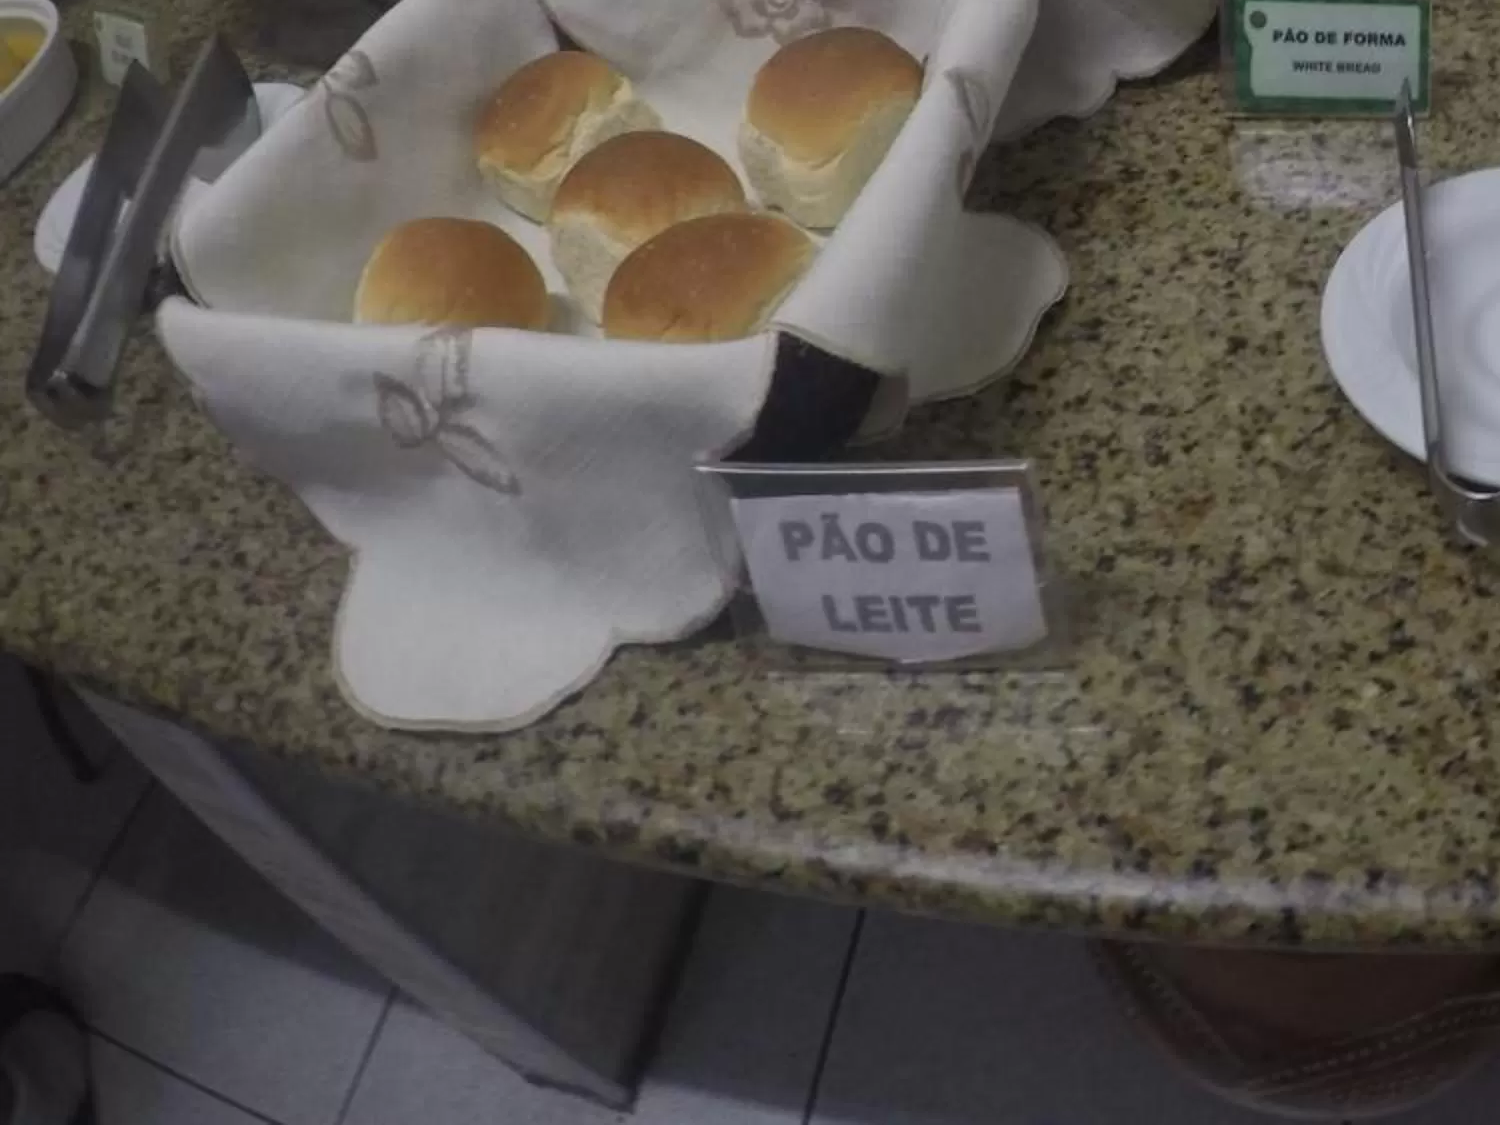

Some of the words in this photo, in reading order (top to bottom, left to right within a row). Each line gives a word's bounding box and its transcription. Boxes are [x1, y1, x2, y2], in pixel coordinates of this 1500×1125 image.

[1271, 26, 1309, 44] PÃO
[1314, 30, 1337, 45] DE
[1342, 30, 1406, 47] FORMA
[1292, 60, 1332, 73] WHITE
[1336, 61, 1382, 74] BREAD
[778, 511, 896, 564] PÃO
[911, 520, 992, 563] DE
[820, 593, 984, 634] LEITE
